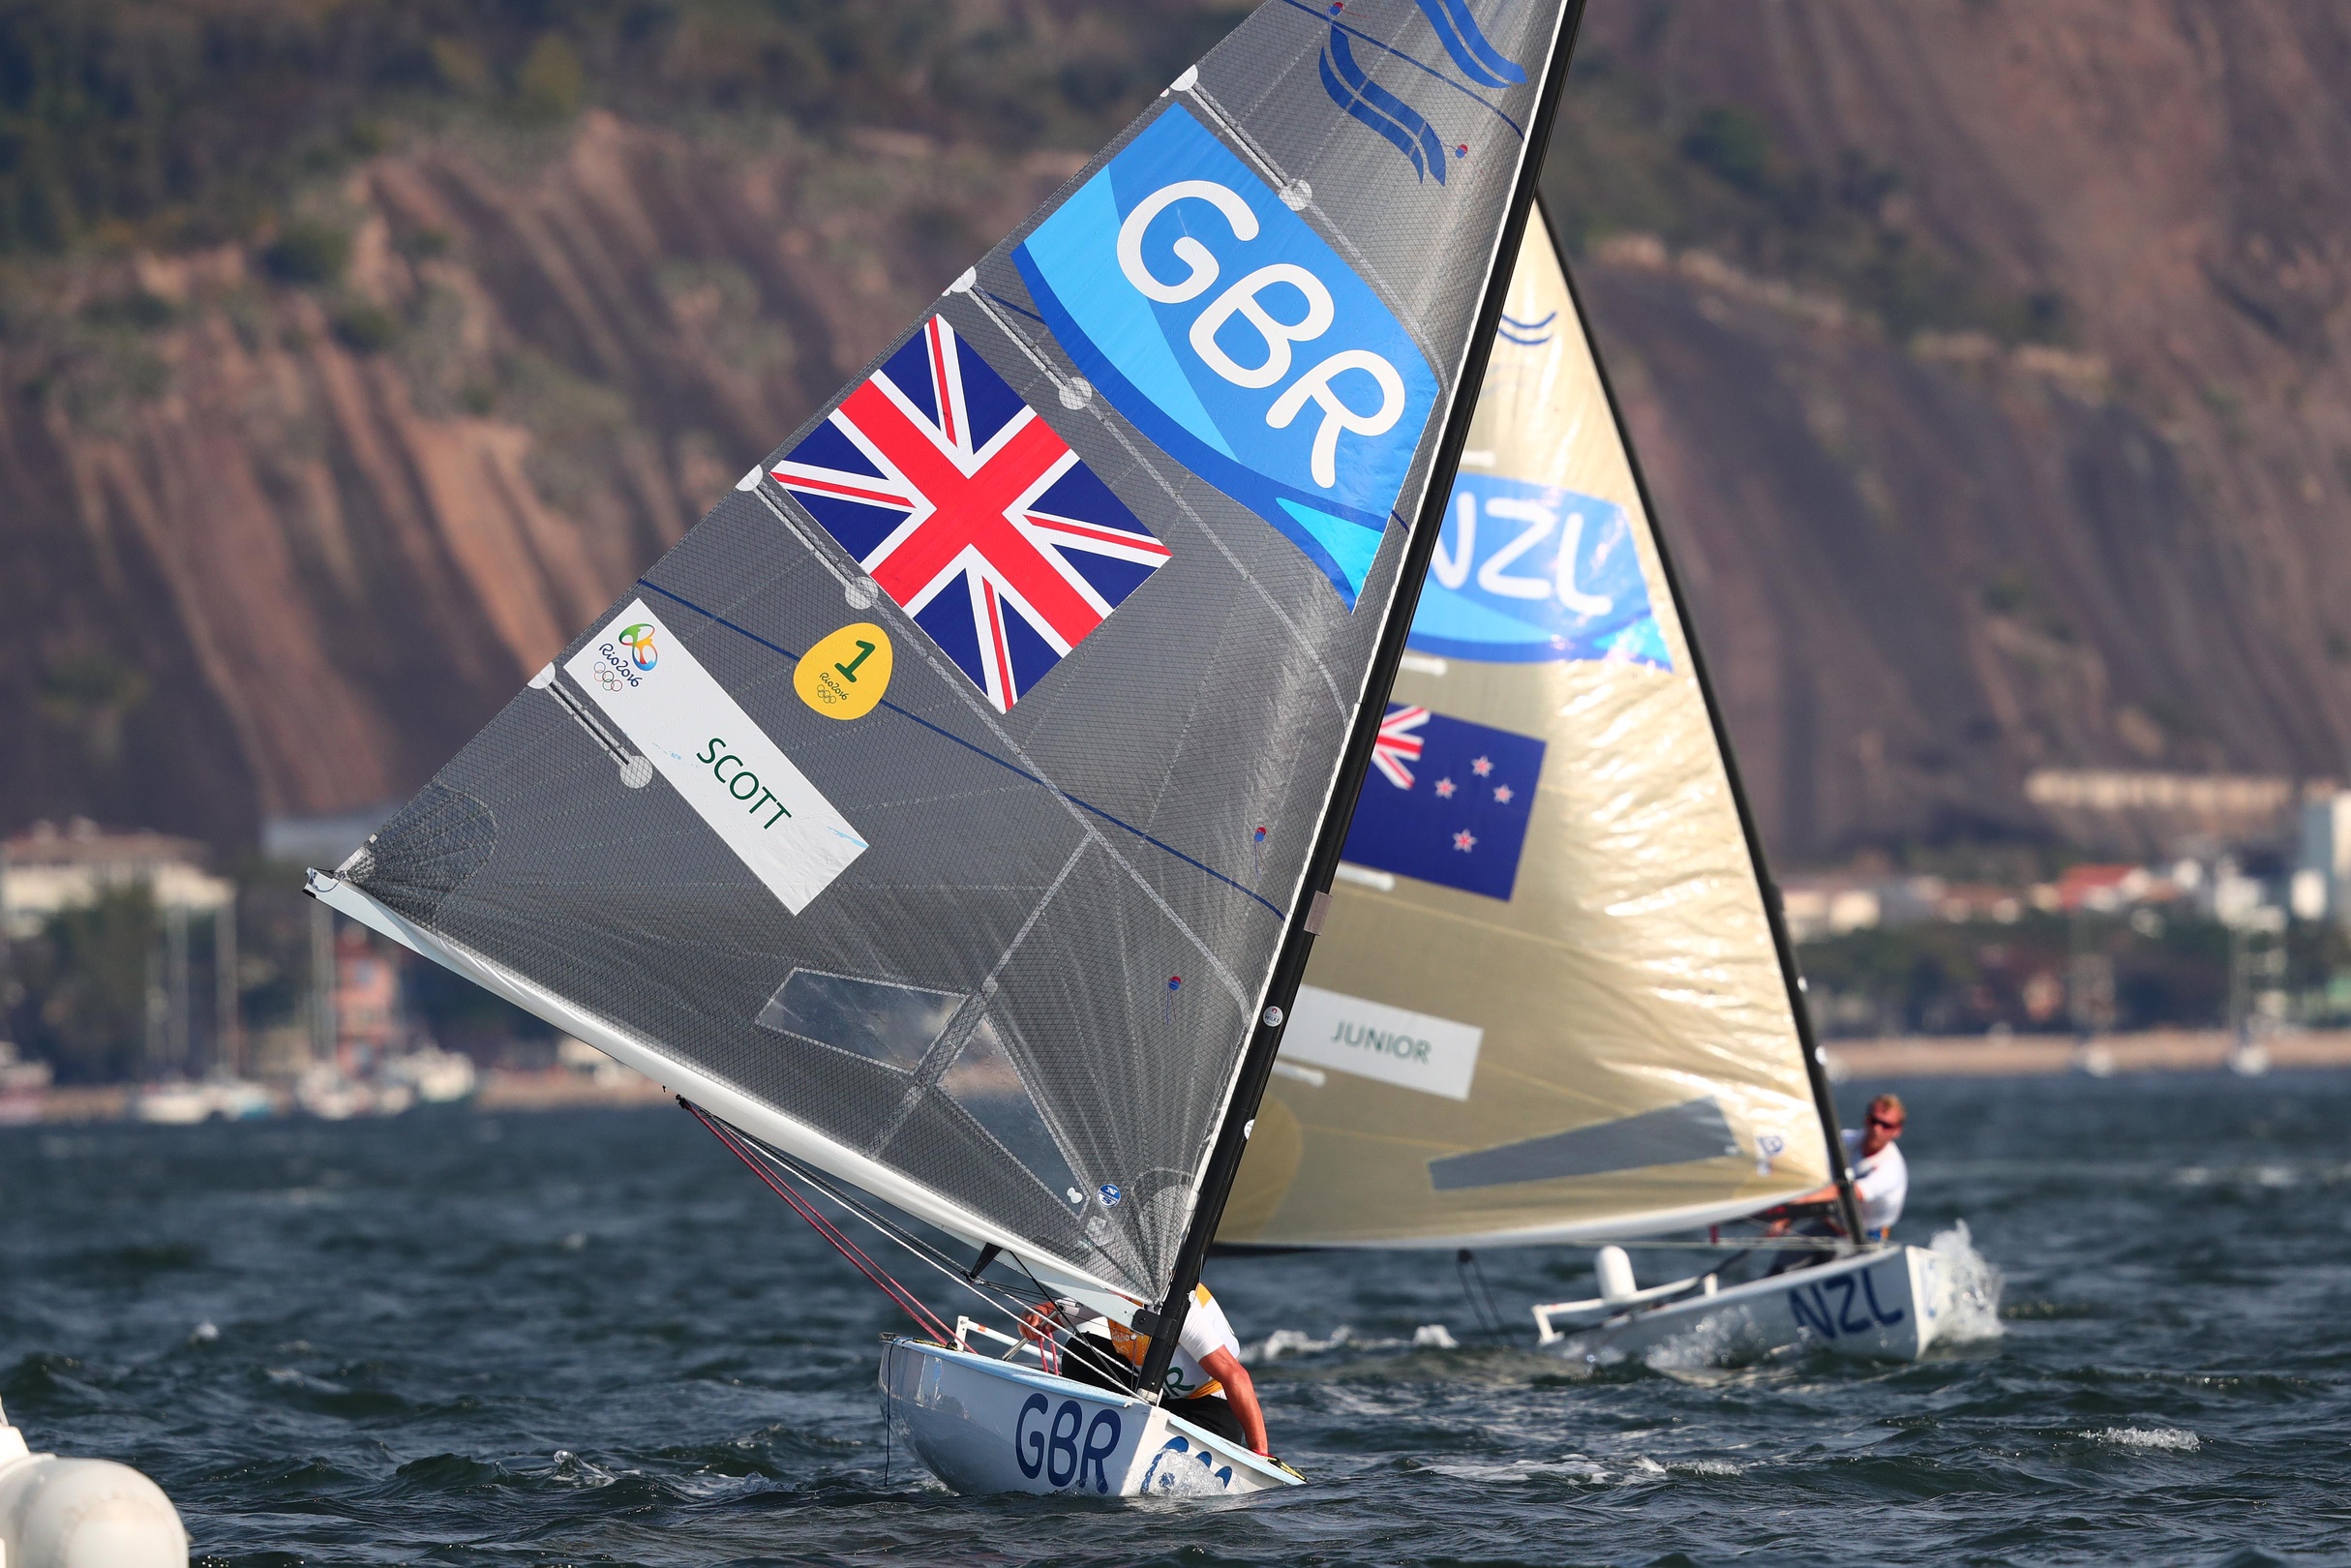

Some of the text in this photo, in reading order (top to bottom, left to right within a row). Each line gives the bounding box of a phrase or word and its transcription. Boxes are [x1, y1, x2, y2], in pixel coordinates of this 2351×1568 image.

[1117, 180, 1405, 488] GBR
[834, 640, 876, 683] 1
[696, 738, 793, 830] SCOTT
[1330, 1020, 1432, 1065] JUNIOR
[1788, 1268, 1906, 1340] NZL
[1015, 1392, 1123, 1494] GBR
